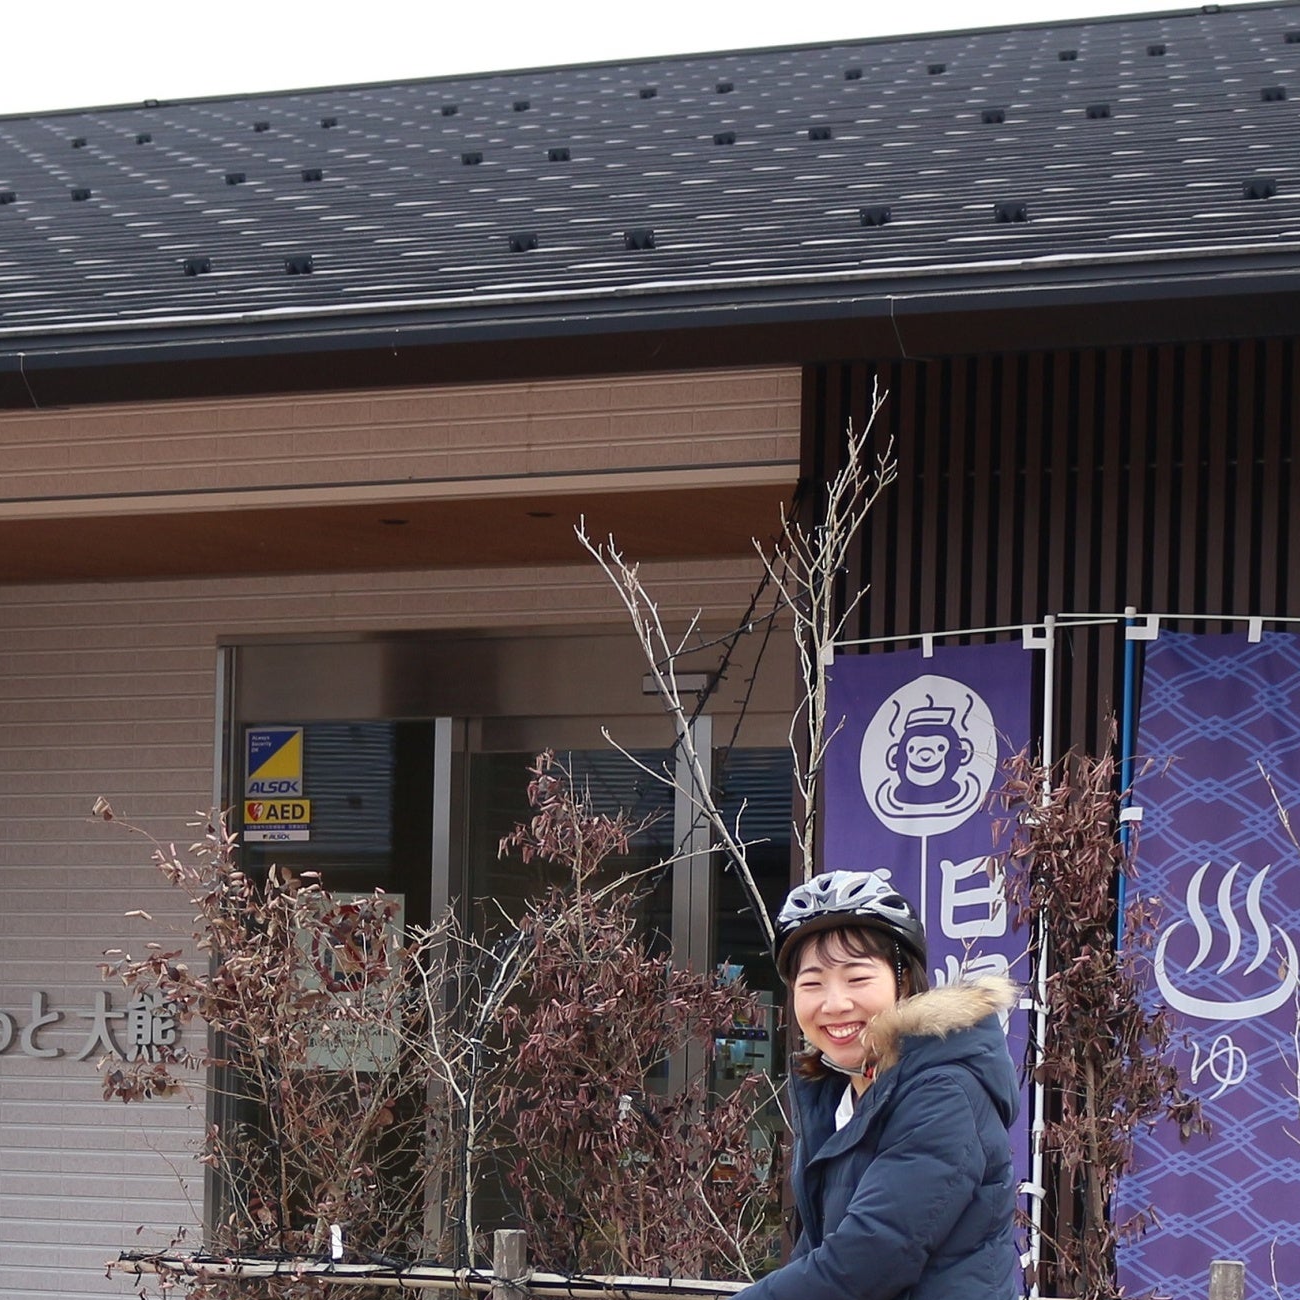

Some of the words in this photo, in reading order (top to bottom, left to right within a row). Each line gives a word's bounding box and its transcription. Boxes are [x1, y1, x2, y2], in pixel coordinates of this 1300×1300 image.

[248, 781, 299, 794] ALSOK
[266, 803, 305, 820] AED
[1190, 1034, 1248, 1100] ゆ
